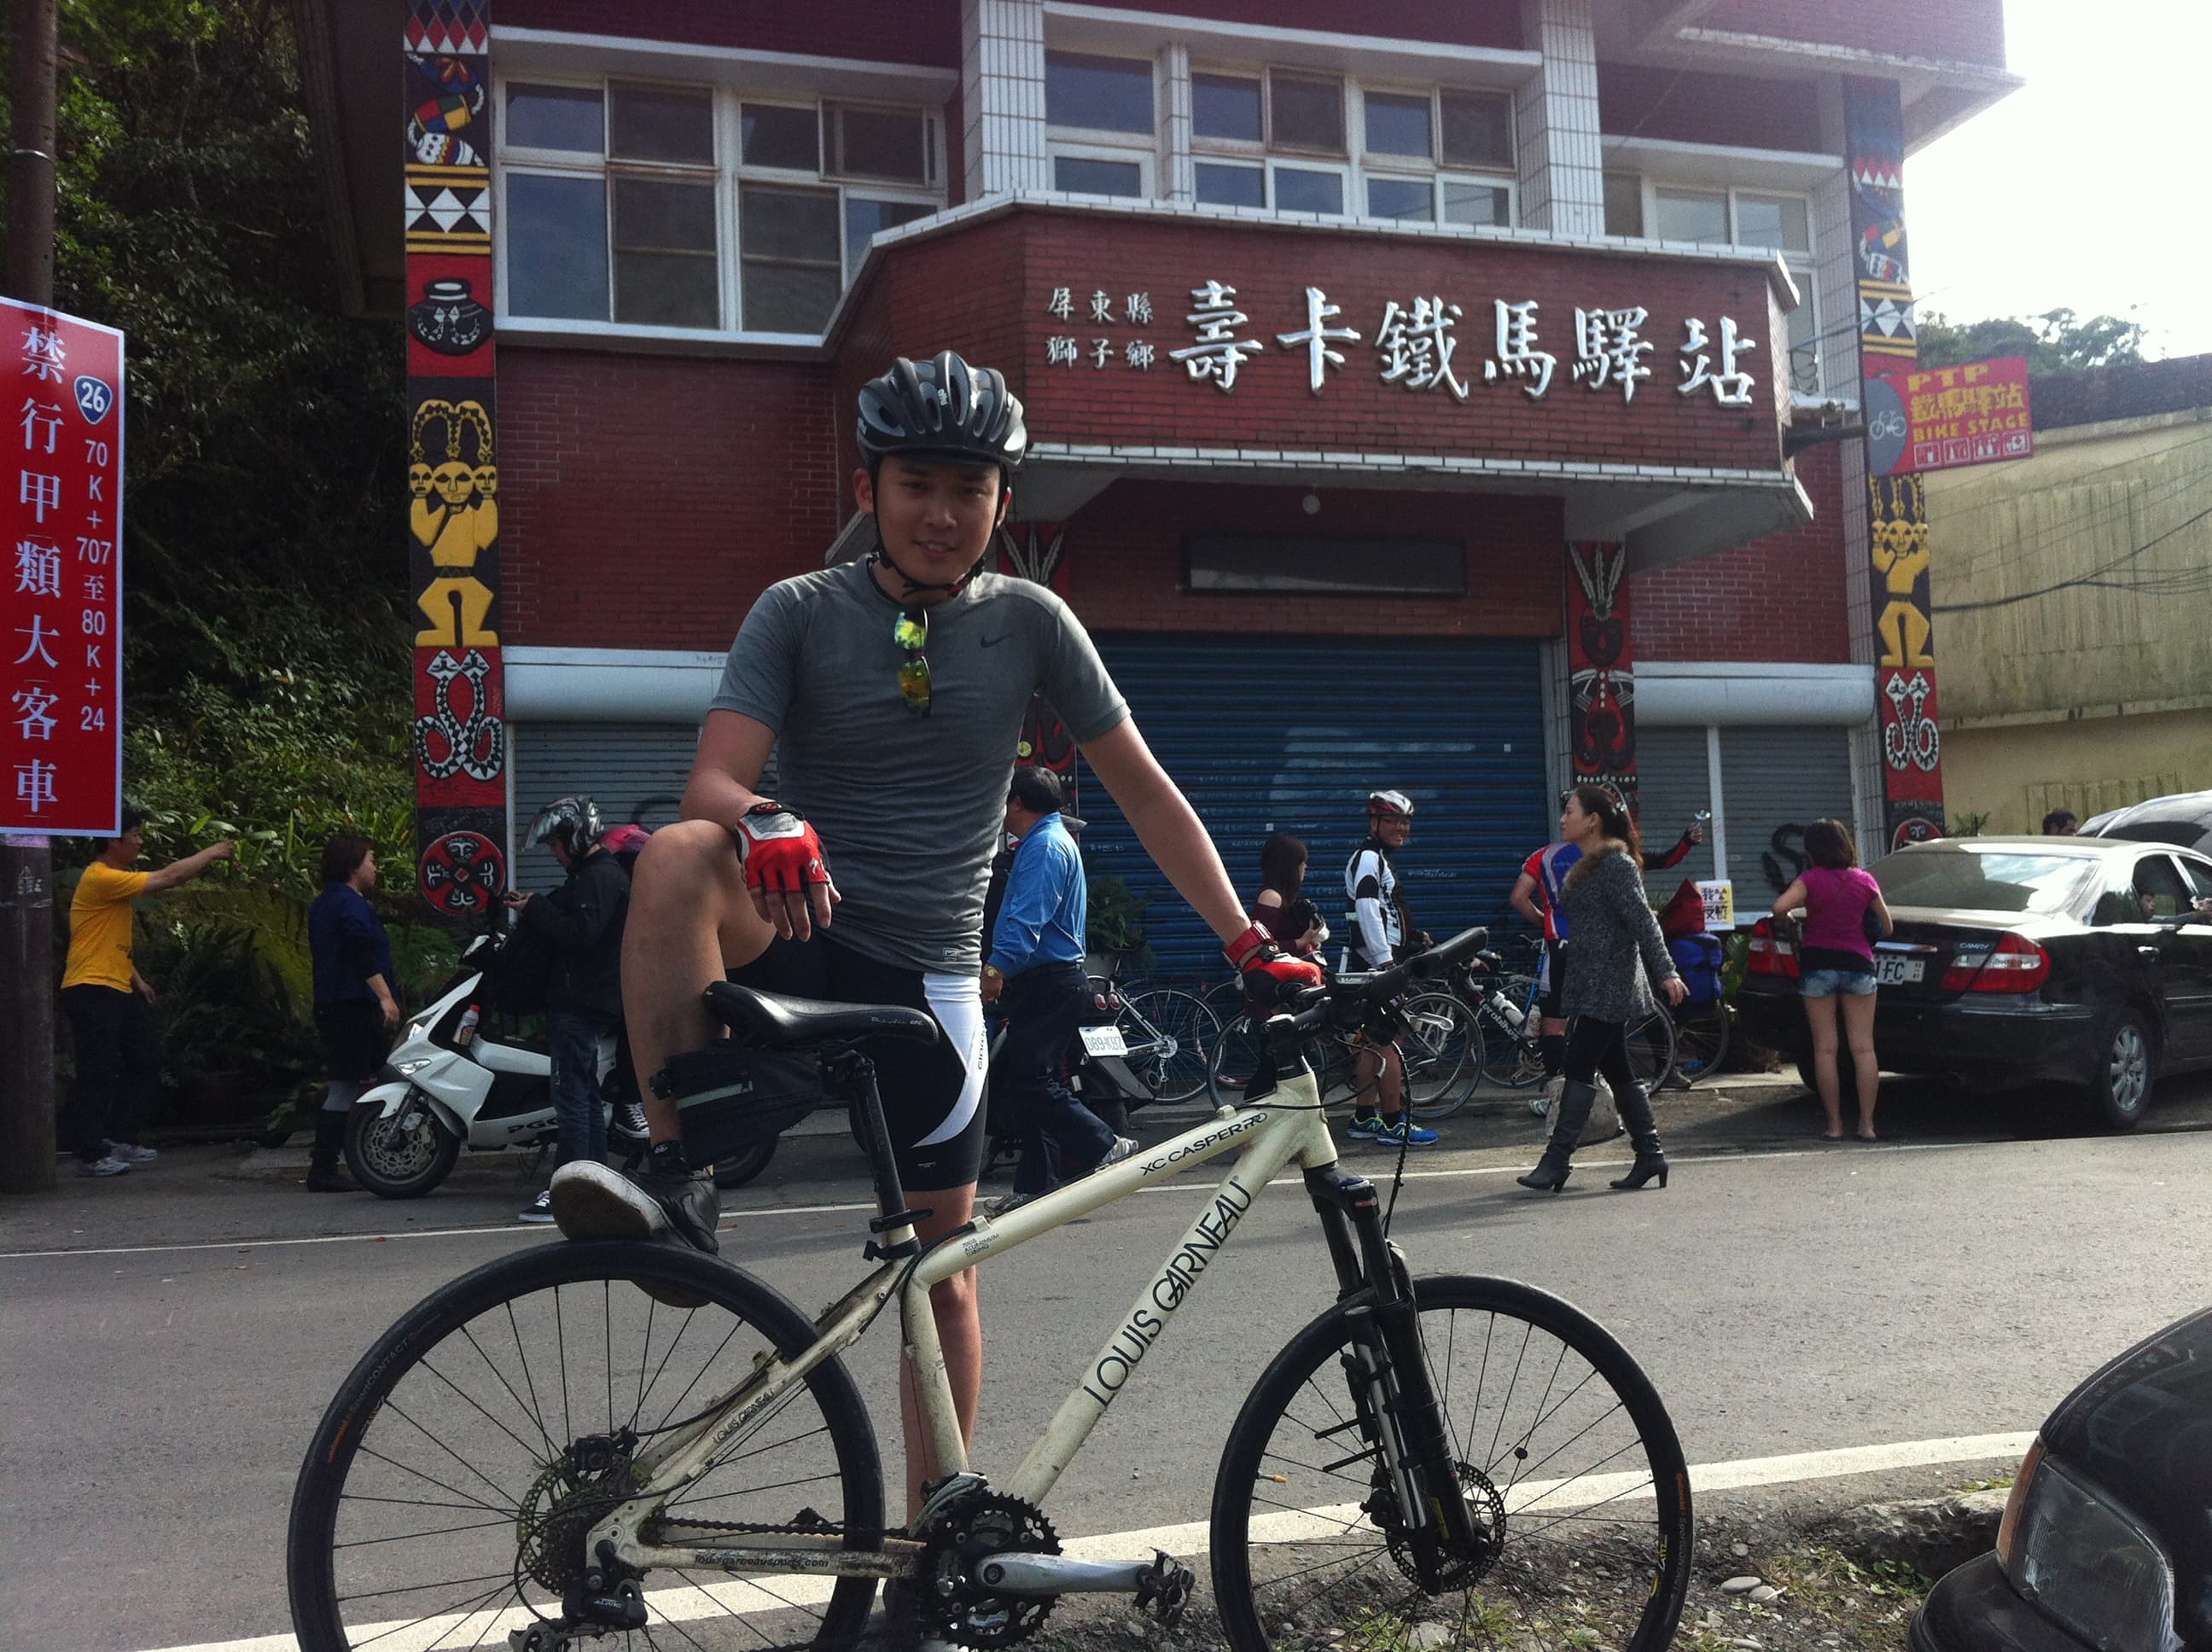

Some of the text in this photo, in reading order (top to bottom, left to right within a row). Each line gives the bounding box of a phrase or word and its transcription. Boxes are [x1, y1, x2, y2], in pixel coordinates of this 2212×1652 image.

[1048, 288, 1154, 324] 屏東縣
[1047, 334, 1155, 372] 獅子鄉
[1168, 280, 1756, 408] 壽卡鐵馬驛站
[80, 381, 104, 412] 26
[1968, 411, 2030, 434] STAGE
[12, 325, 67, 813] 禁行甲類大客車
[1140, 1158, 1167, 1176] XC
[1168, 1123, 1243, 1162] CASPER
[1083, 1180, 1253, 1407] LOUIS GARNEAU
[713, 1418, 740, 1444] LOUIS
